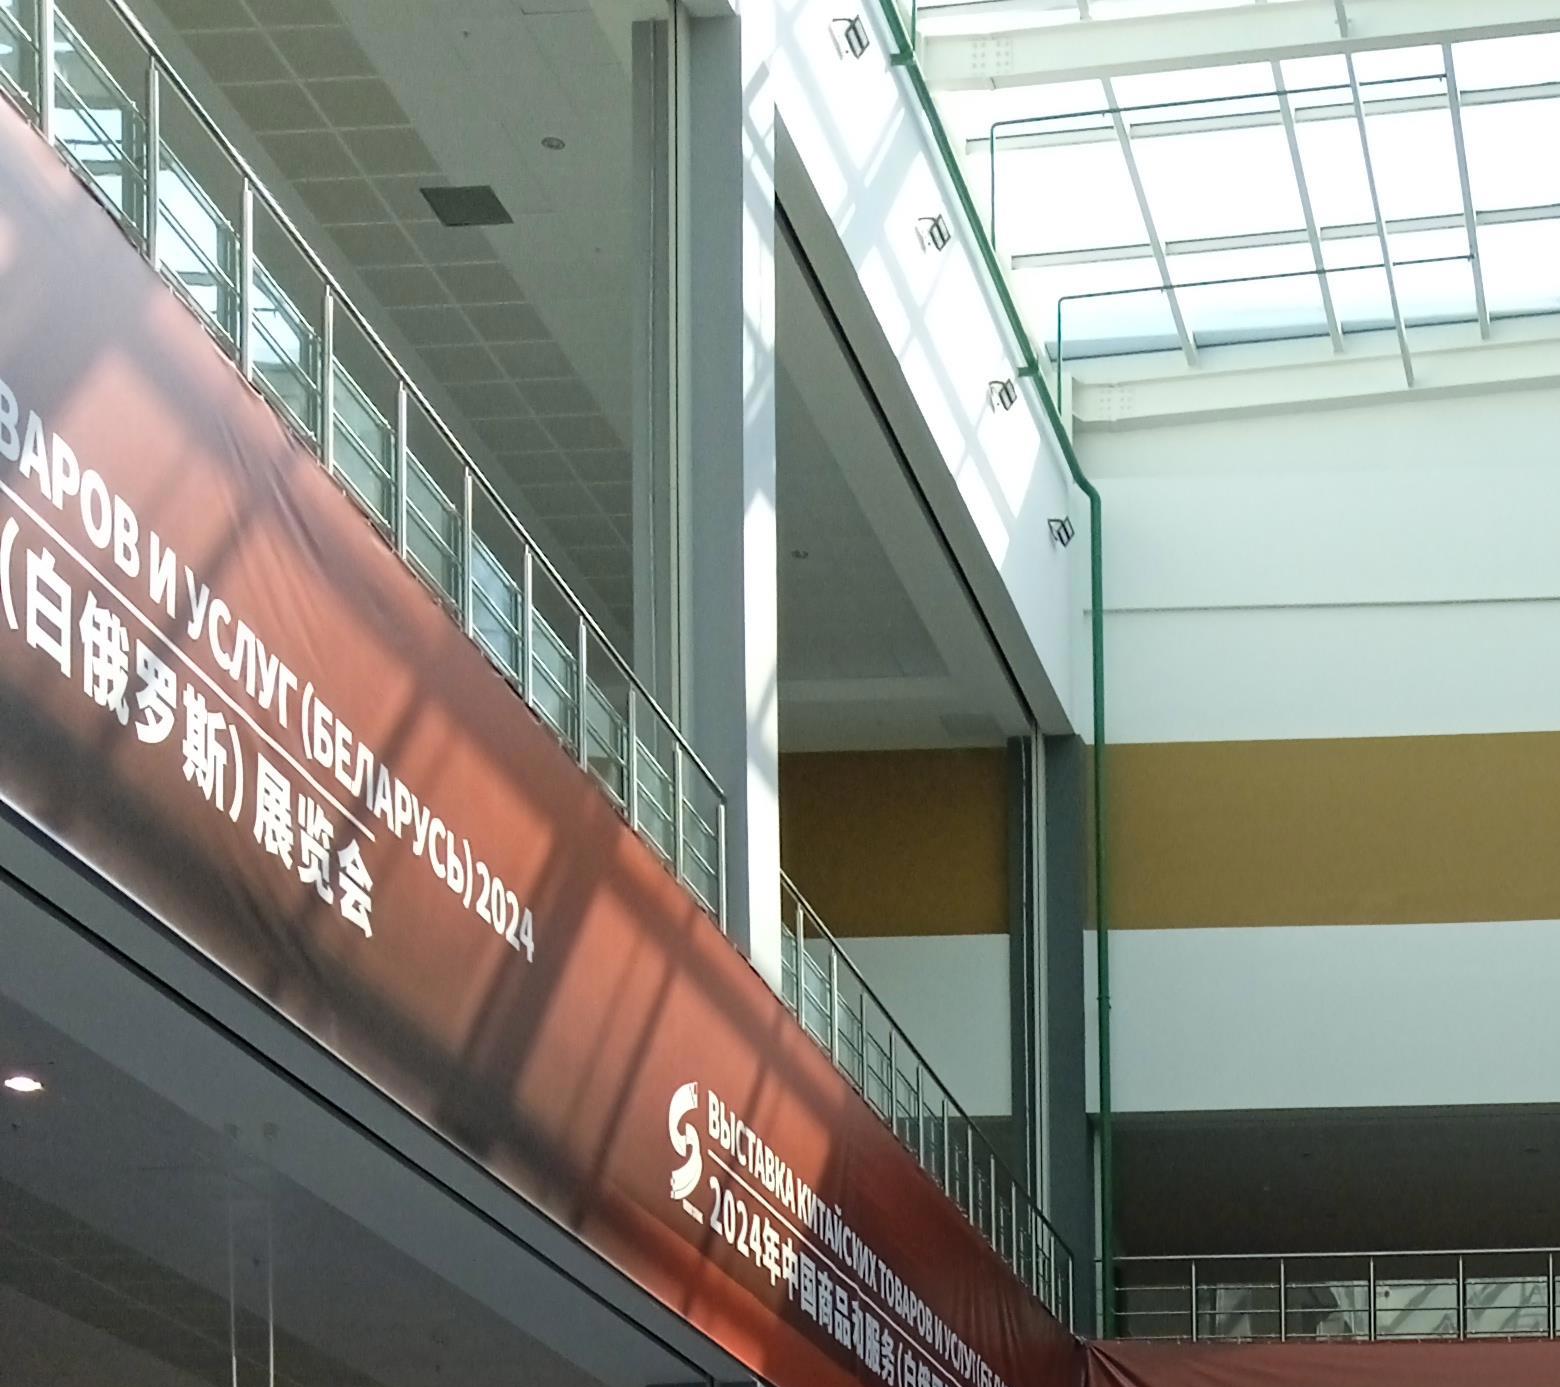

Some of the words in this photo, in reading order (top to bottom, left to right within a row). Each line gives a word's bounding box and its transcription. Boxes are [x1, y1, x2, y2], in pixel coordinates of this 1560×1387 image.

[150, 530, 177, 620] И
[184, 564, 299, 727] УСЛУГ
[301, 681, 472, 908] (БЕЛАРУСЬ)
[475, 863, 535, 963] 2024
[708, 1089, 796, 1215] ВЫСТАВКА
[796, 1177, 878, 1293] КИТАЙСКИХ
[878, 1258, 933, 1344] ТОВАРОВ
[934, 1314, 943, 1354] И
[943, 1324, 976, 1384] УСЛУГ
